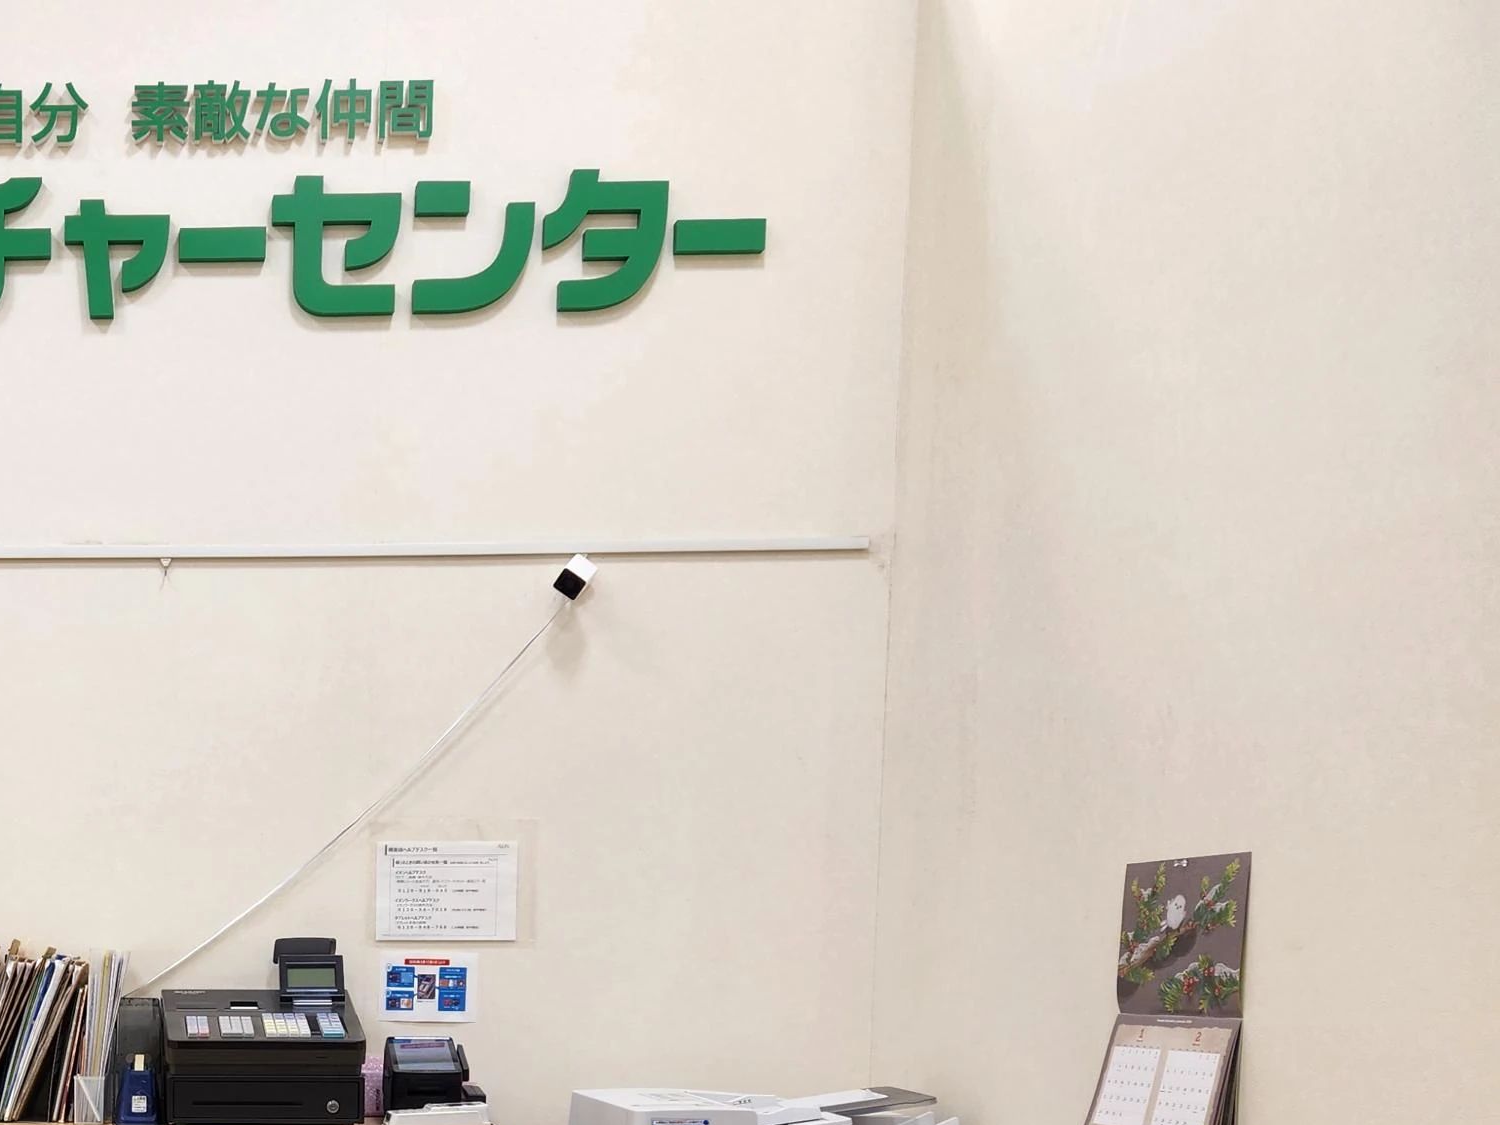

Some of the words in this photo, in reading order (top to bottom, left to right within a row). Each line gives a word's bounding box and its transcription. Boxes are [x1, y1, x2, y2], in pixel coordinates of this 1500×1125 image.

[131, 79, 436, 144] 素敵な仲間
